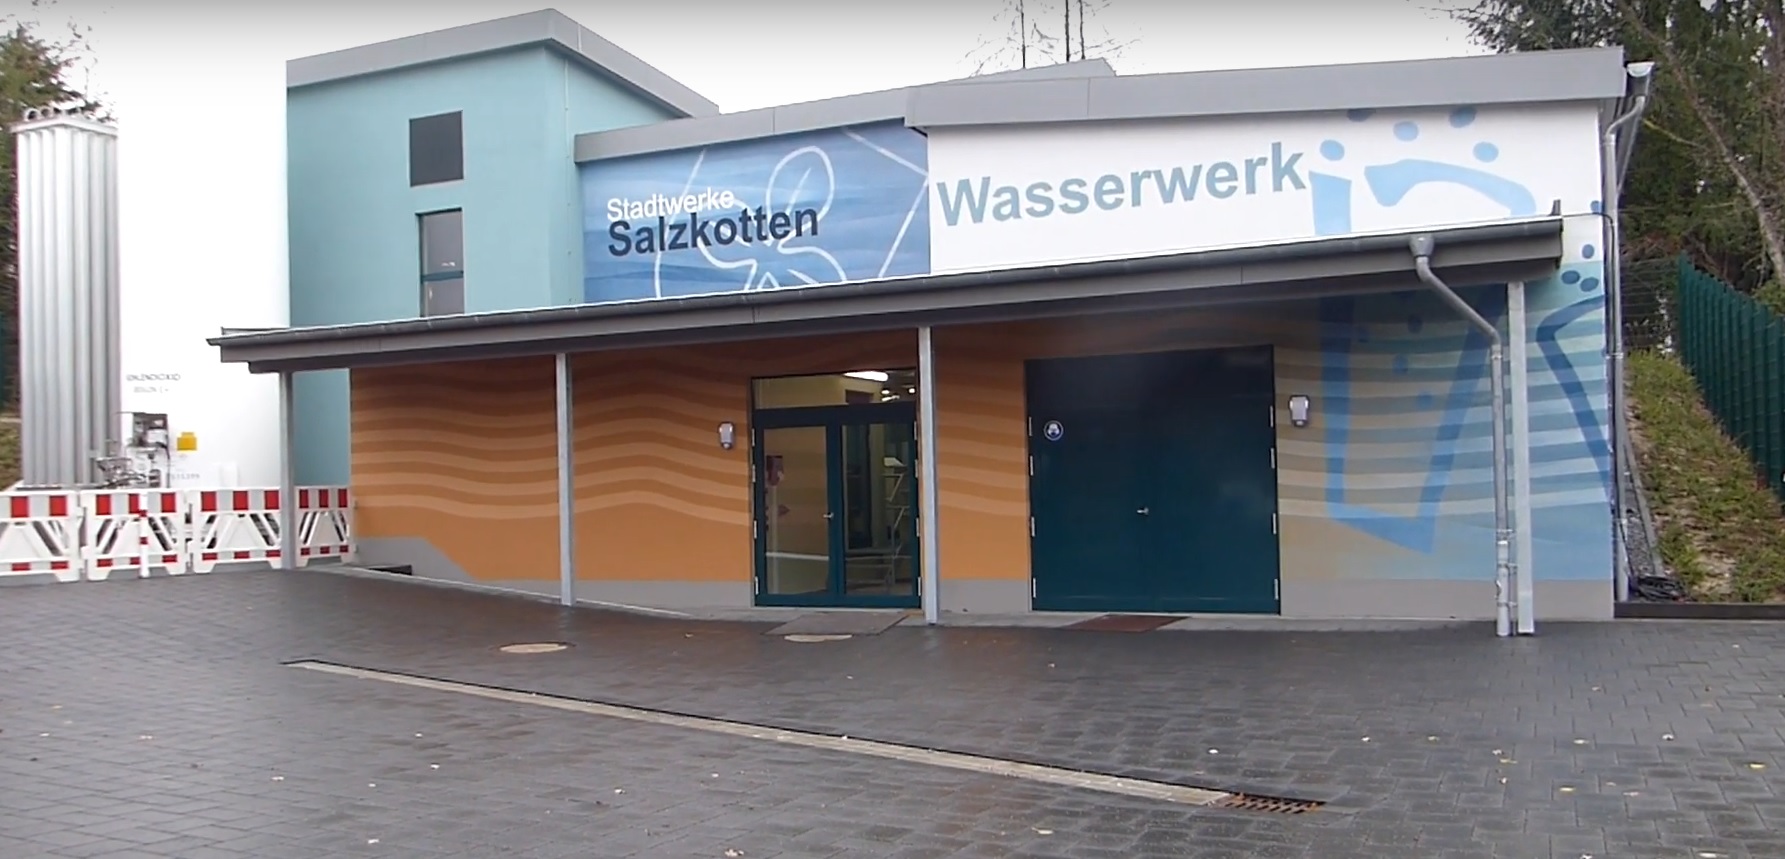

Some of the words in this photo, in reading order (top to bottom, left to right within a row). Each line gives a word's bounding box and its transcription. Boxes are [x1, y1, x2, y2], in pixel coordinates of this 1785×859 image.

[607, 187, 734, 221] Stadtwerke
[936, 141, 1307, 226] Wasserwerk
[608, 206, 819, 256] Salzkotten
